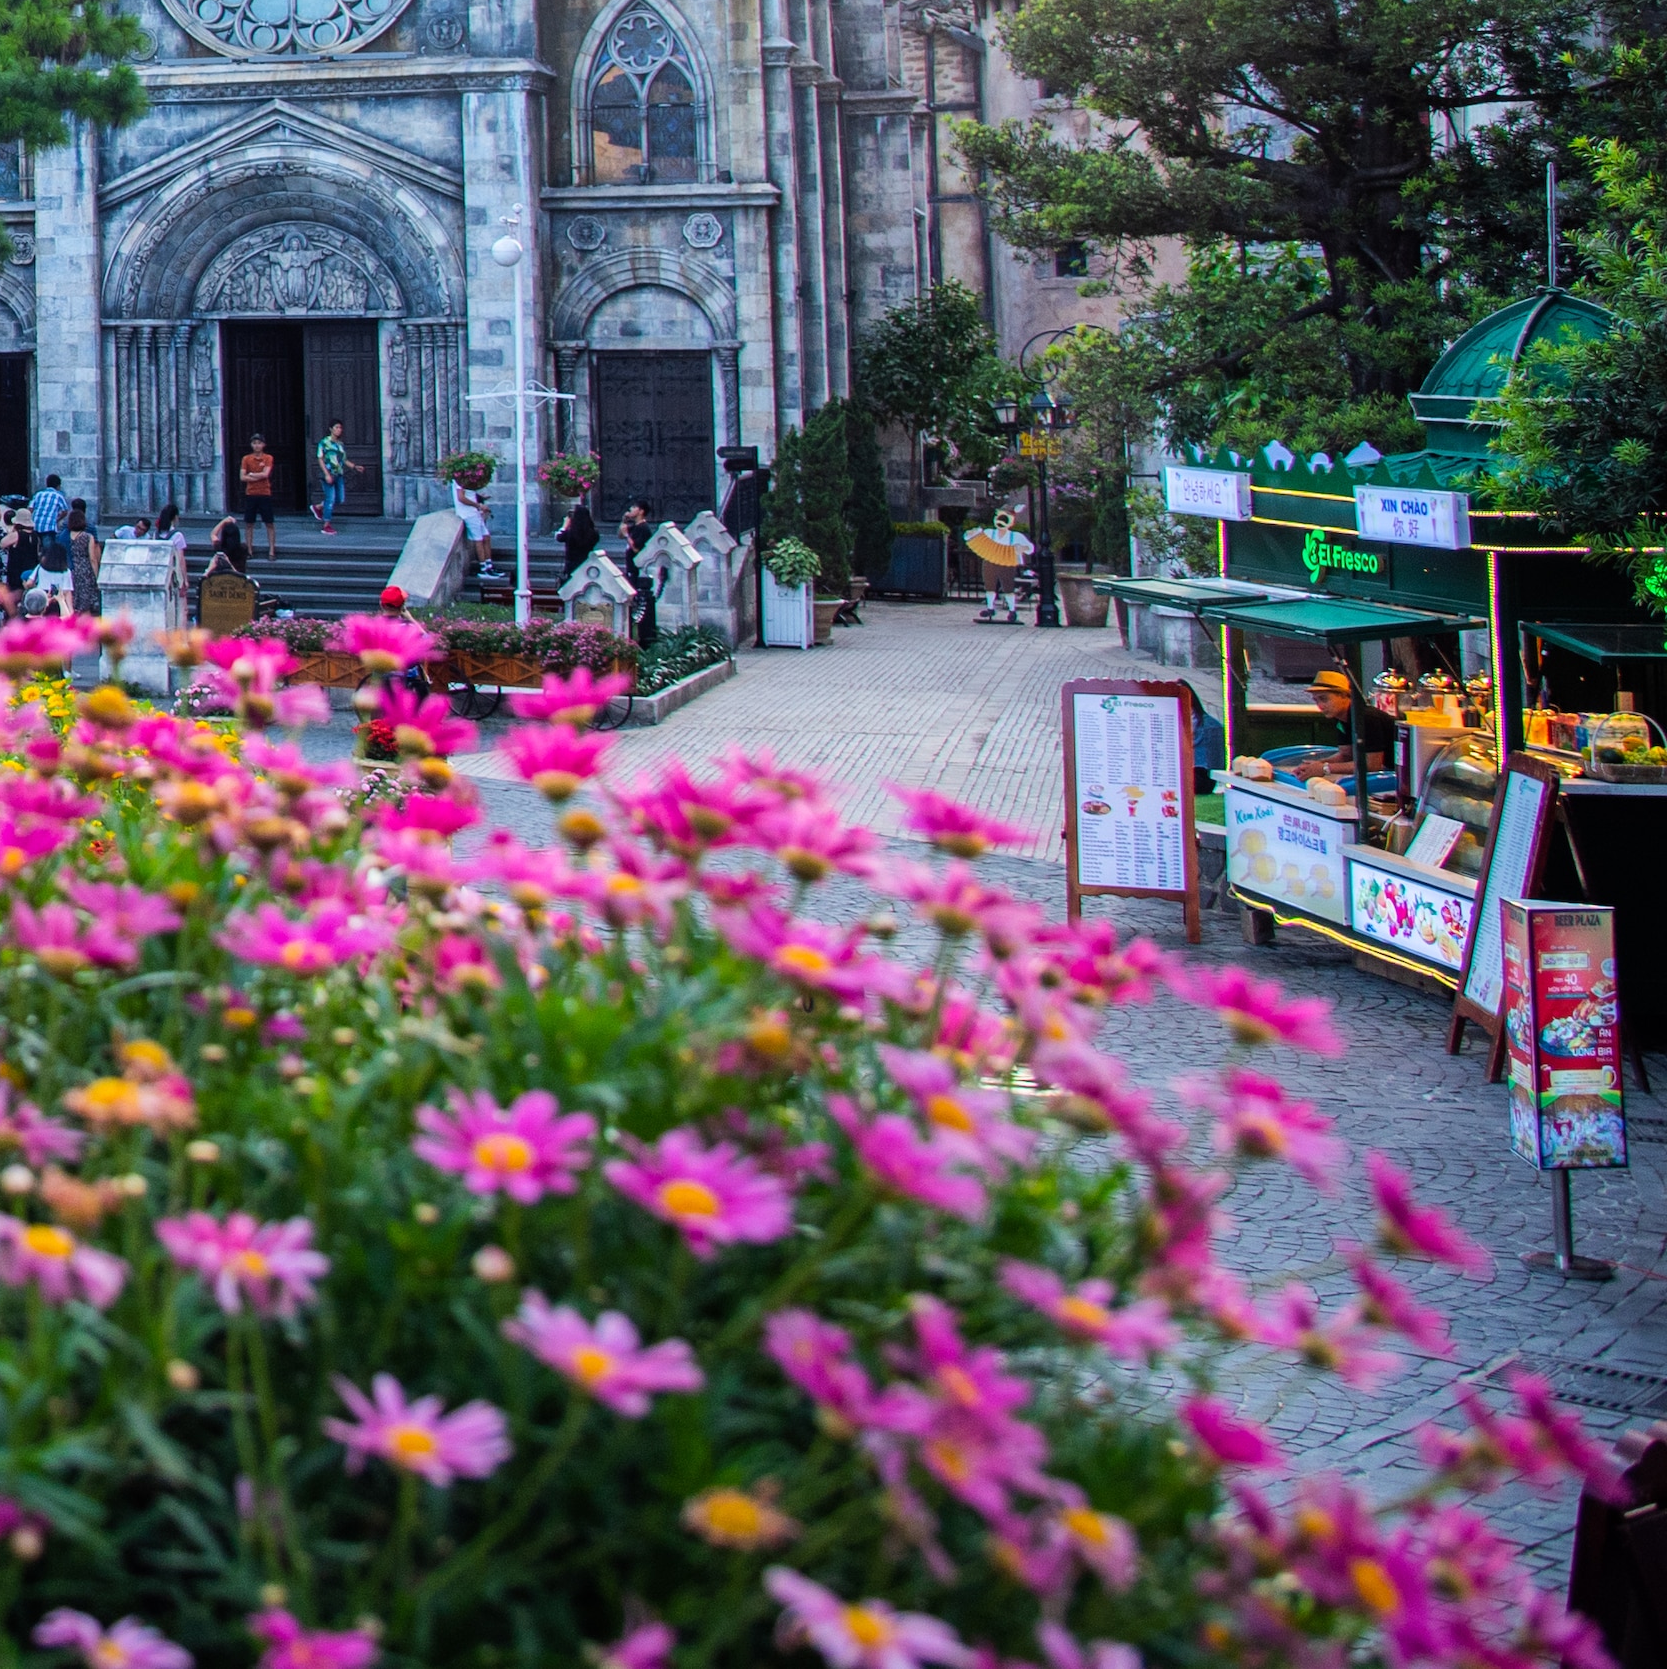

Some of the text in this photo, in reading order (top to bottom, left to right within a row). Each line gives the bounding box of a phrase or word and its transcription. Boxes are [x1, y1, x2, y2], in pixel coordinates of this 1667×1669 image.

[1183, 478, 1222, 505] 안녕하세요
[1380, 497, 1428, 516] XIN CHÀO
[1393, 517, 1420, 539] 你好
[1318, 543, 1378, 574] El Fresco
[1235, 809, 1254, 824] Kem
[1282, 814, 1321, 837] 芒果奶油
[1277, 826, 1327, 855] 망고아이스크림
[1555, 914, 1601, 927] BEER PLAZA
[1564, 973, 1578, 985] 40
[1597, 1046, 1613, 1056] BIA
